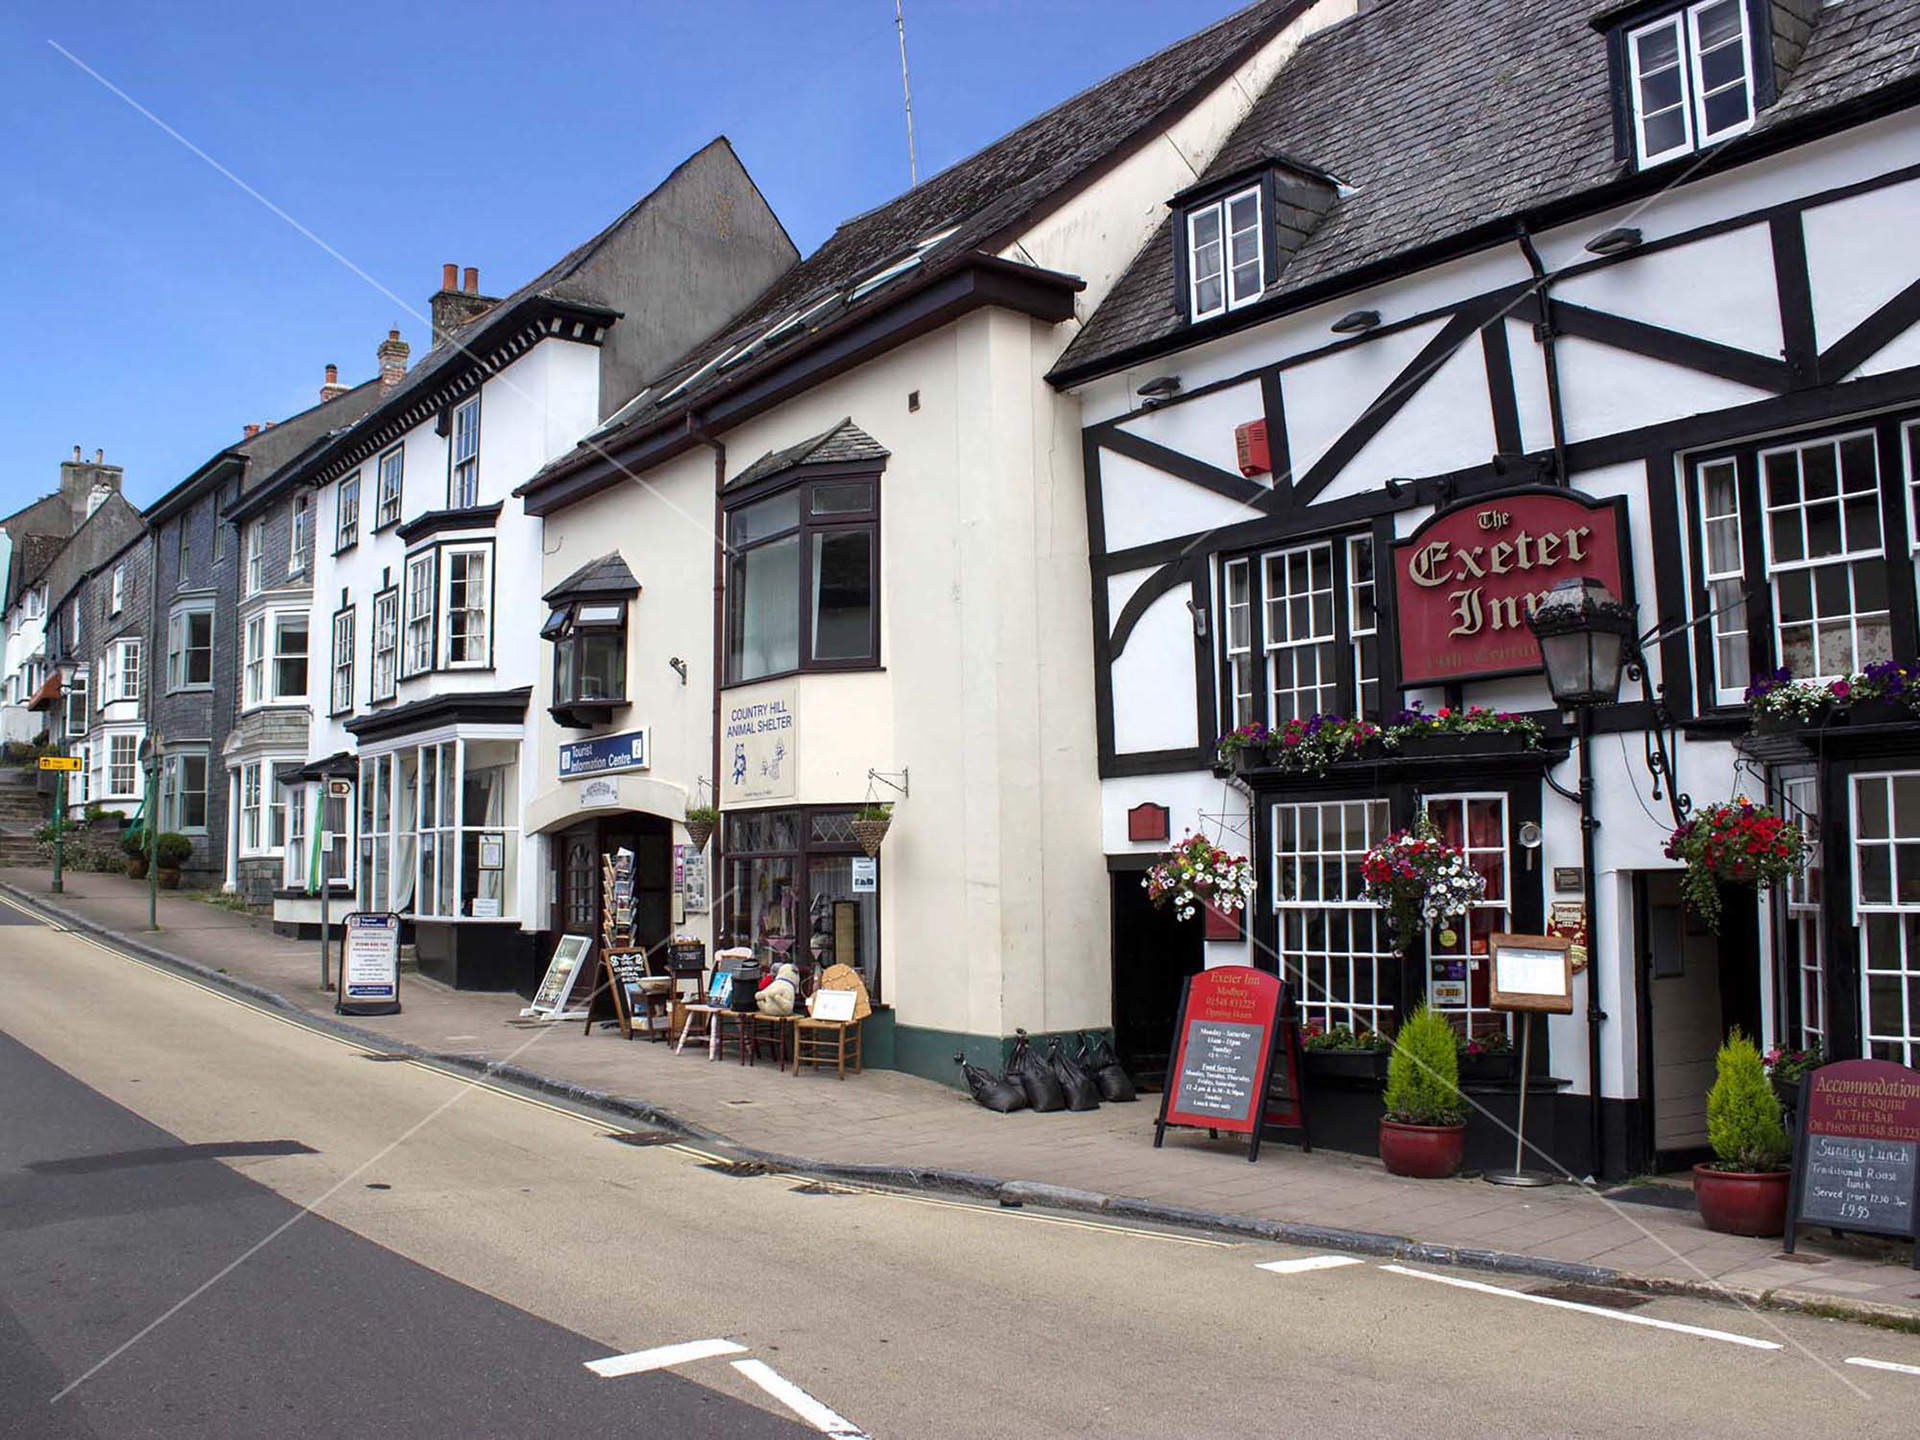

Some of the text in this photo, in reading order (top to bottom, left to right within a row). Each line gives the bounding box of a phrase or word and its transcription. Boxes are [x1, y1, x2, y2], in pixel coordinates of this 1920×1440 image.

[1476, 510, 1511, 531] The
[1408, 525, 1591, 588] Exeter
[731, 701, 787, 722] COUNTRY HILL
[727, 715, 792, 738] ANIMAL SHELTER
[571, 744, 593, 758] Tourist
[571, 753, 632, 772] Information Centre
[1210, 971, 1260, 985] Exeter Inn
[1216, 986, 1248, 999] Modbury
[1200, 1028, 1221, 1037] Monday
[1226, 1030, 1251, 1040] Saturday
[1212, 1046, 1232, 1054] Sunday
[1216, 1065, 1237, 1073] Service
[1815, 1076, 1920, 1099] Accommodation
[1825, 1094, 1907, 1111] PLEASE ENQUIRE
[1834, 1109, 1895, 1124] AT THE BAR
[1809, 1120, 1920, 1139] OR PHONE 01548 831225
[1816, 1138, 1910, 1163] Sunday Lunch
[1812, 1163, 1897, 1181] Traditional Roast
[1812, 1186, 1843, 1199] Served
[1846, 1193, 1867, 1203] from
